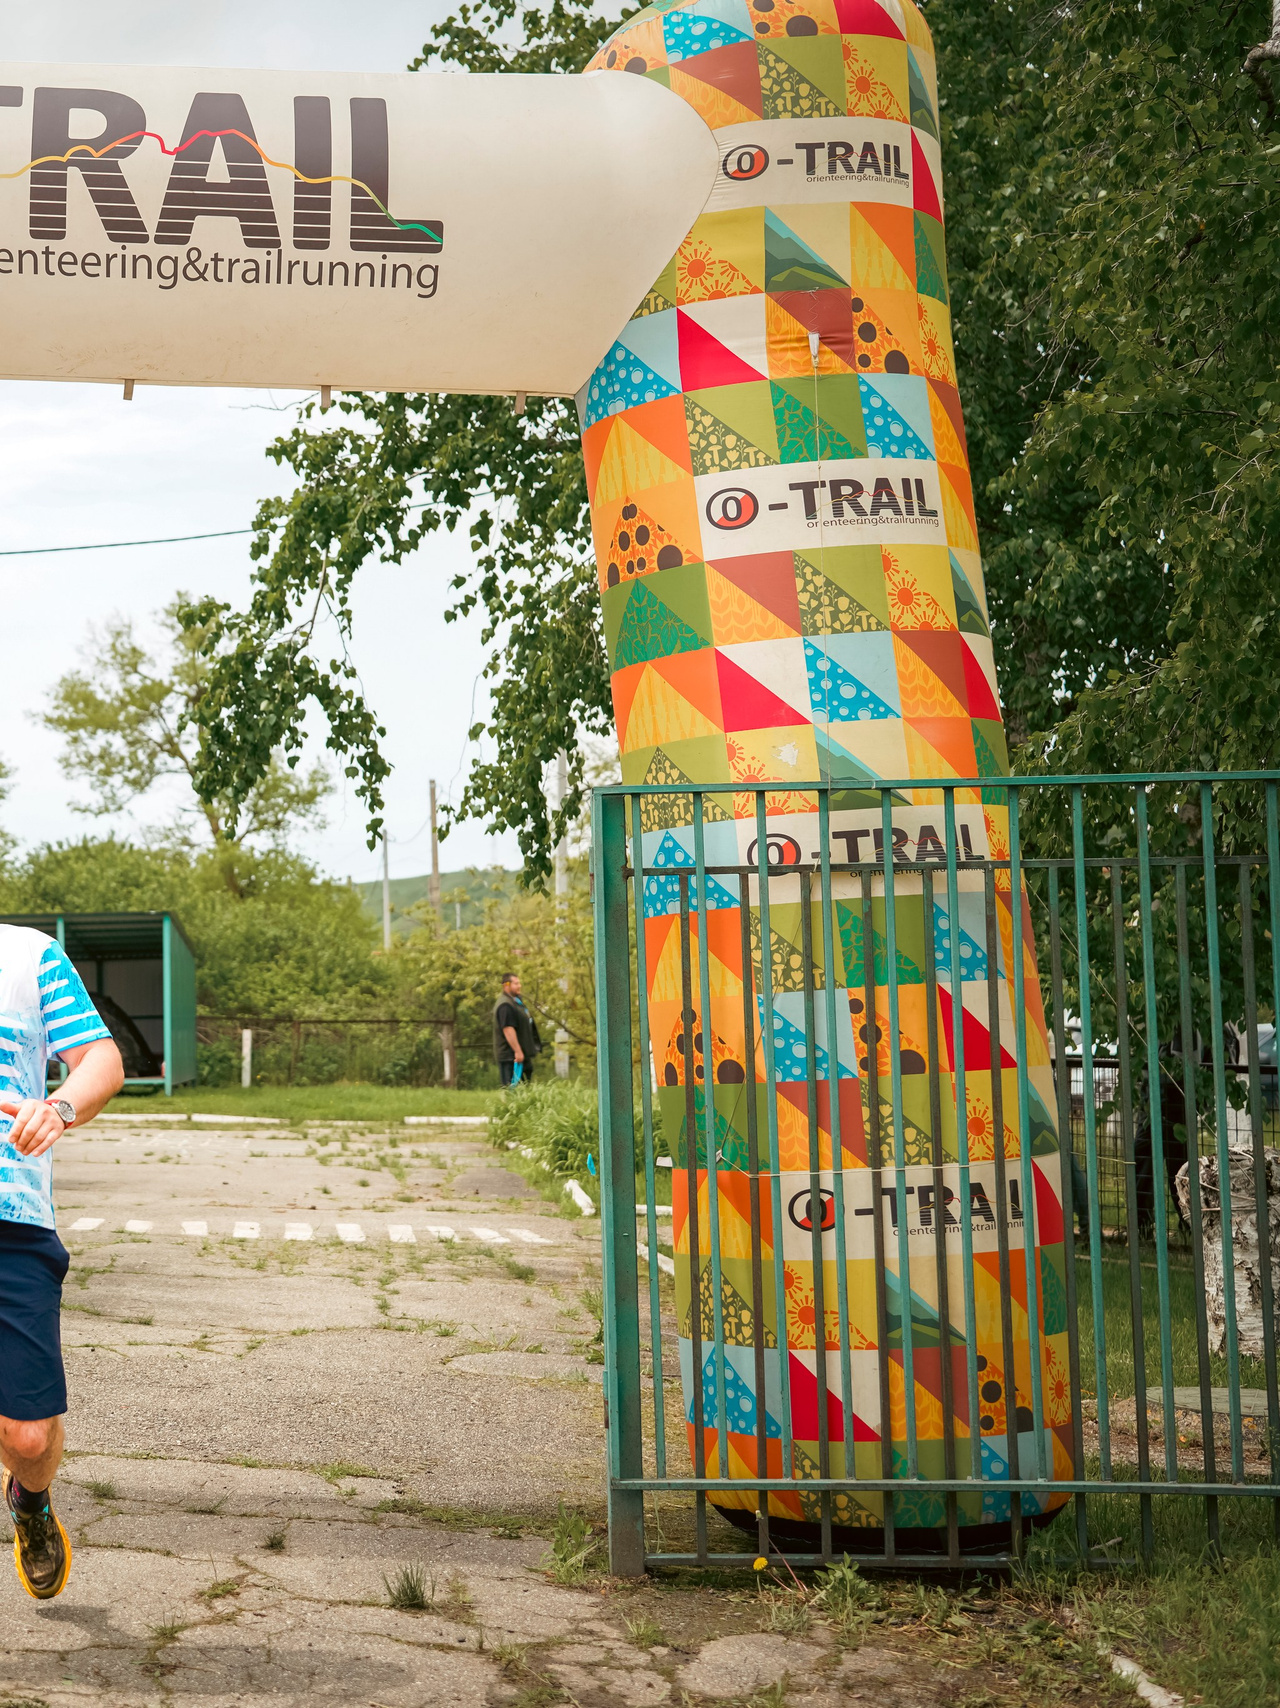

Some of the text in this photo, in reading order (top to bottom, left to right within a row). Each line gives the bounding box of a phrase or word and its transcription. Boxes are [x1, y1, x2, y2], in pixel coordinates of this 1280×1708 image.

[806, 174, 910, 188] orienteering&trailrunning
[806, 515, 939, 528] orenteering&trailrunning
[747, 824, 985, 876] O-TRAL
